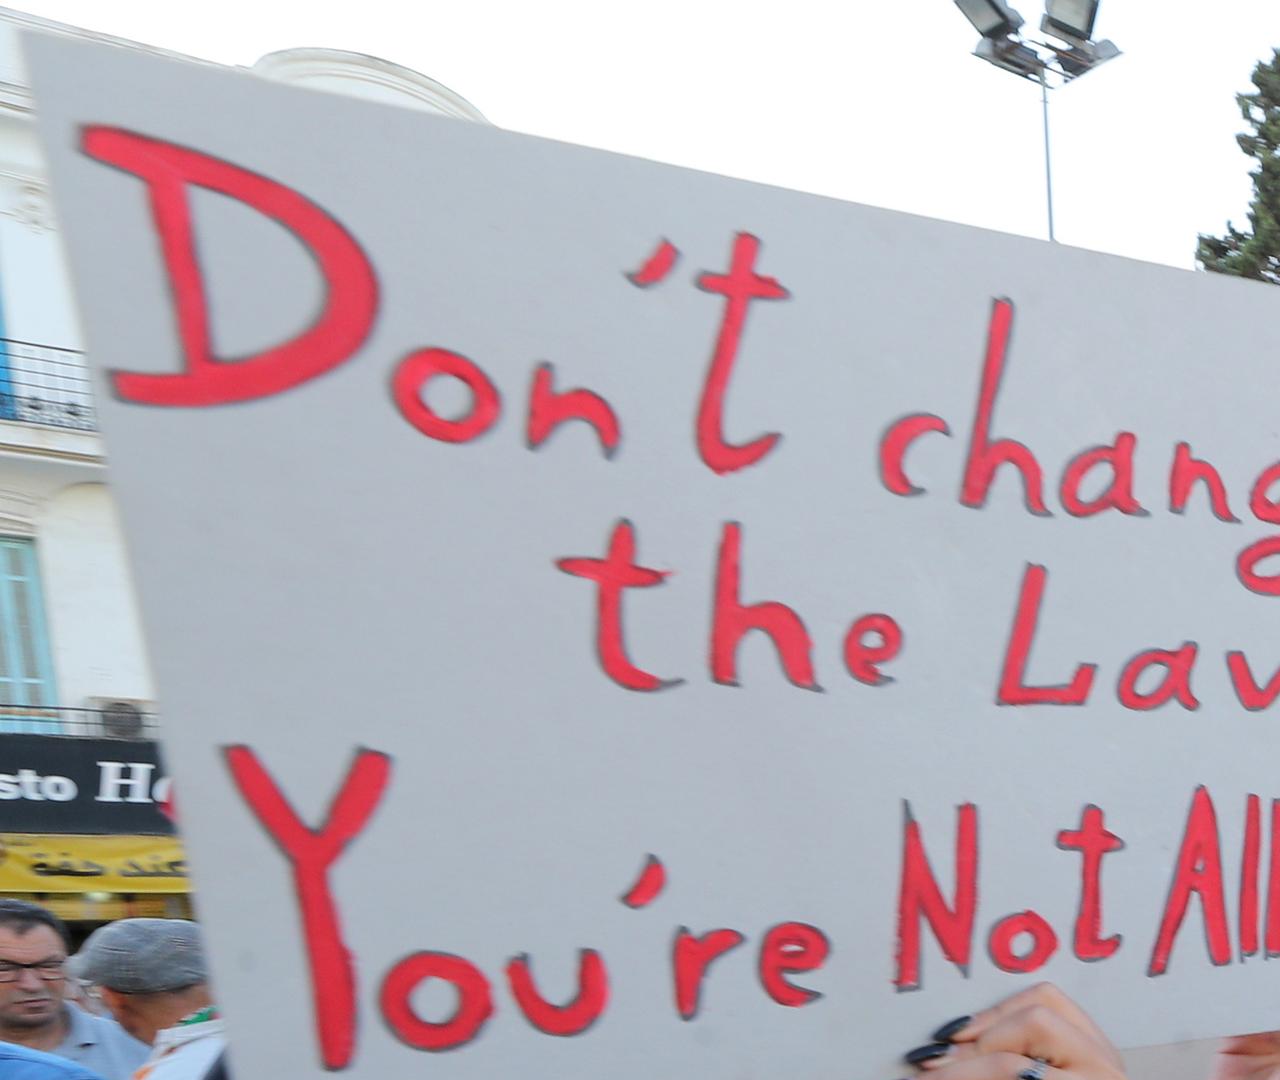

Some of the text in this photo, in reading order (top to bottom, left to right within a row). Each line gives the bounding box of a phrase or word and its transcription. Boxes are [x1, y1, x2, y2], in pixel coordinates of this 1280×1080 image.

[76, 122, 792, 478] Don't
[554, 516, 905, 694] the
[222, 742, 832, 1071] You're
[890, 797, 1126, 992] Not
